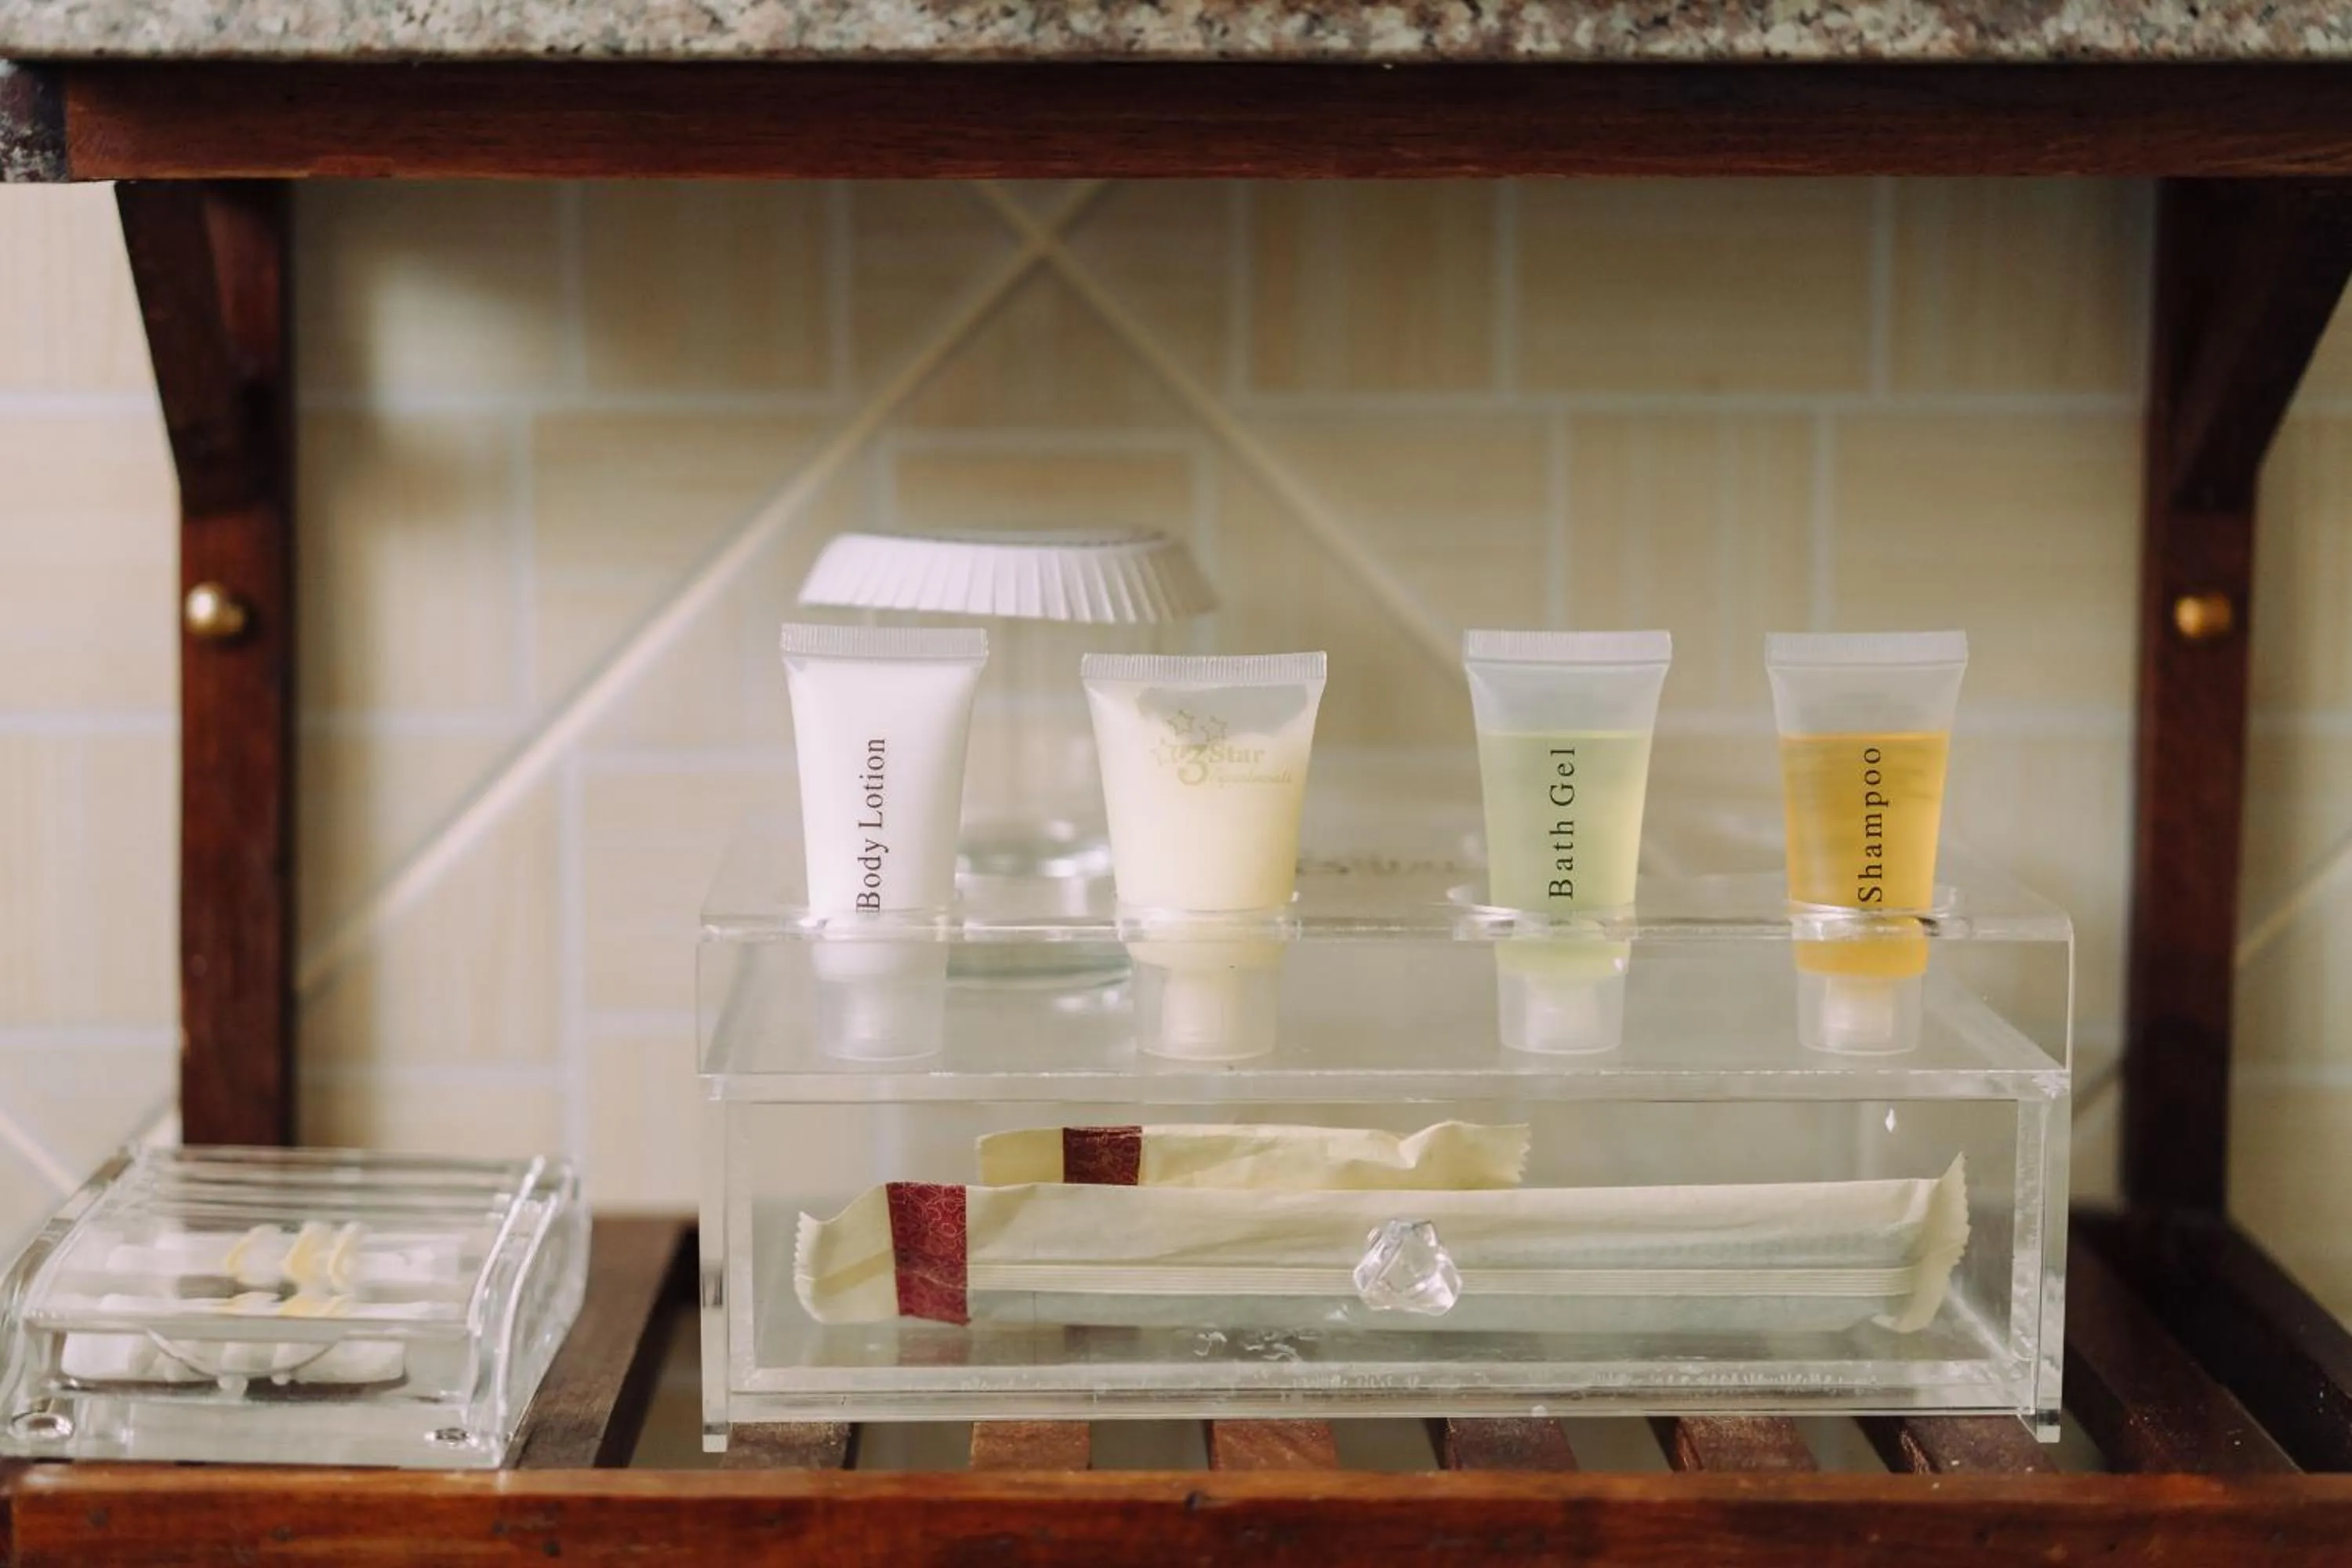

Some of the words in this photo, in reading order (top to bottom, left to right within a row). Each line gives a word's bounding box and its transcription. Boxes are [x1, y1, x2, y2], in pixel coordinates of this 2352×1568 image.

[858, 739, 886, 828] Lotion
[1548, 747, 1576, 807] Gel
[1548, 820, 1574, 901] Bath
[1857, 747, 1889, 903] Shampoo
[855, 838, 889, 913] Body
